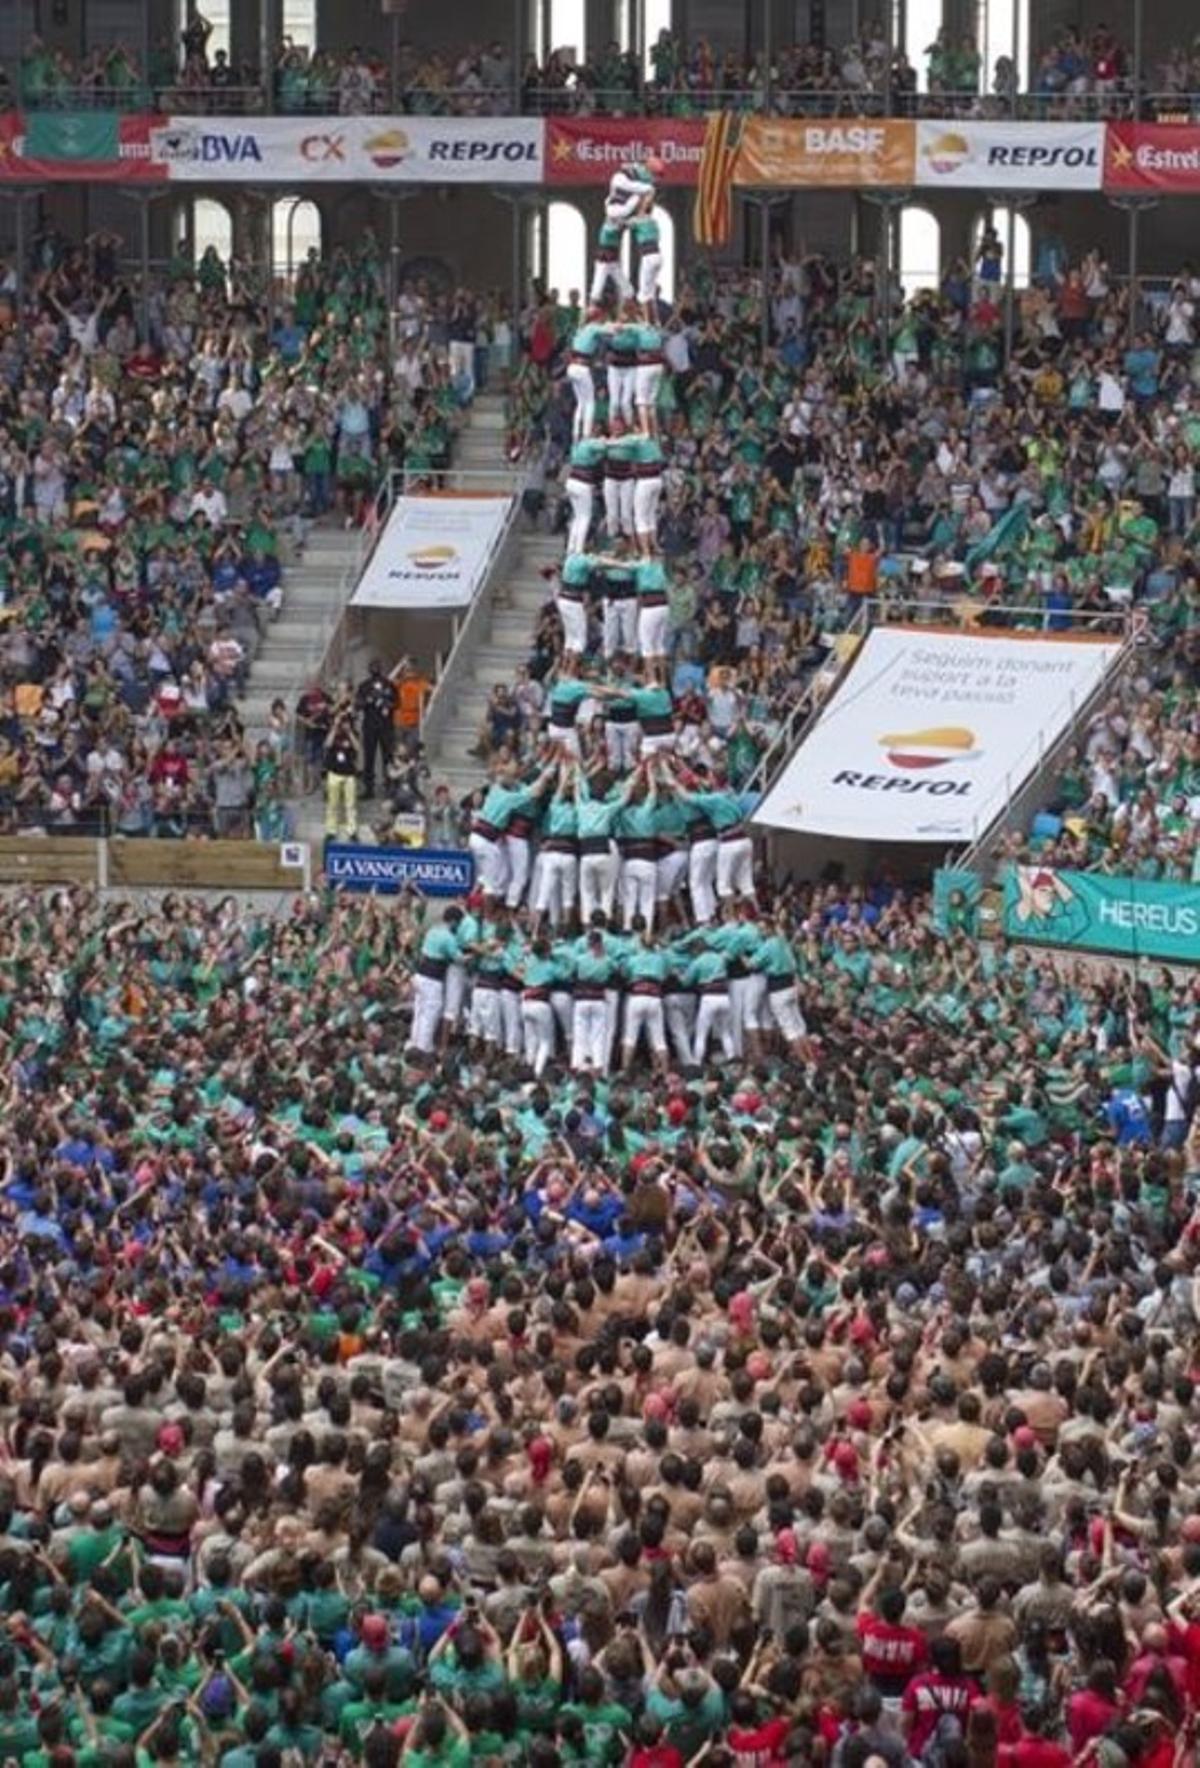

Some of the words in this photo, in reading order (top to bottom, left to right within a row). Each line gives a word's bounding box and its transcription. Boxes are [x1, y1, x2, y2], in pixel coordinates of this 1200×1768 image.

[193, 134, 263, 162] BVA
[300, 134, 346, 162] CX
[428, 141, 541, 162] REPSOL
[577, 139, 655, 163] Estrella
[660, 139, 705, 163] Dam
[805, 127, 886, 153] BASF
[986, 146, 1099, 167] REPSOL
[832, 769, 972, 796] REPSOL
[333, 858, 354, 876] LA
[353, 859, 464, 881] VANGUARDIA
[1100, 898, 1198, 935] HEREUS
